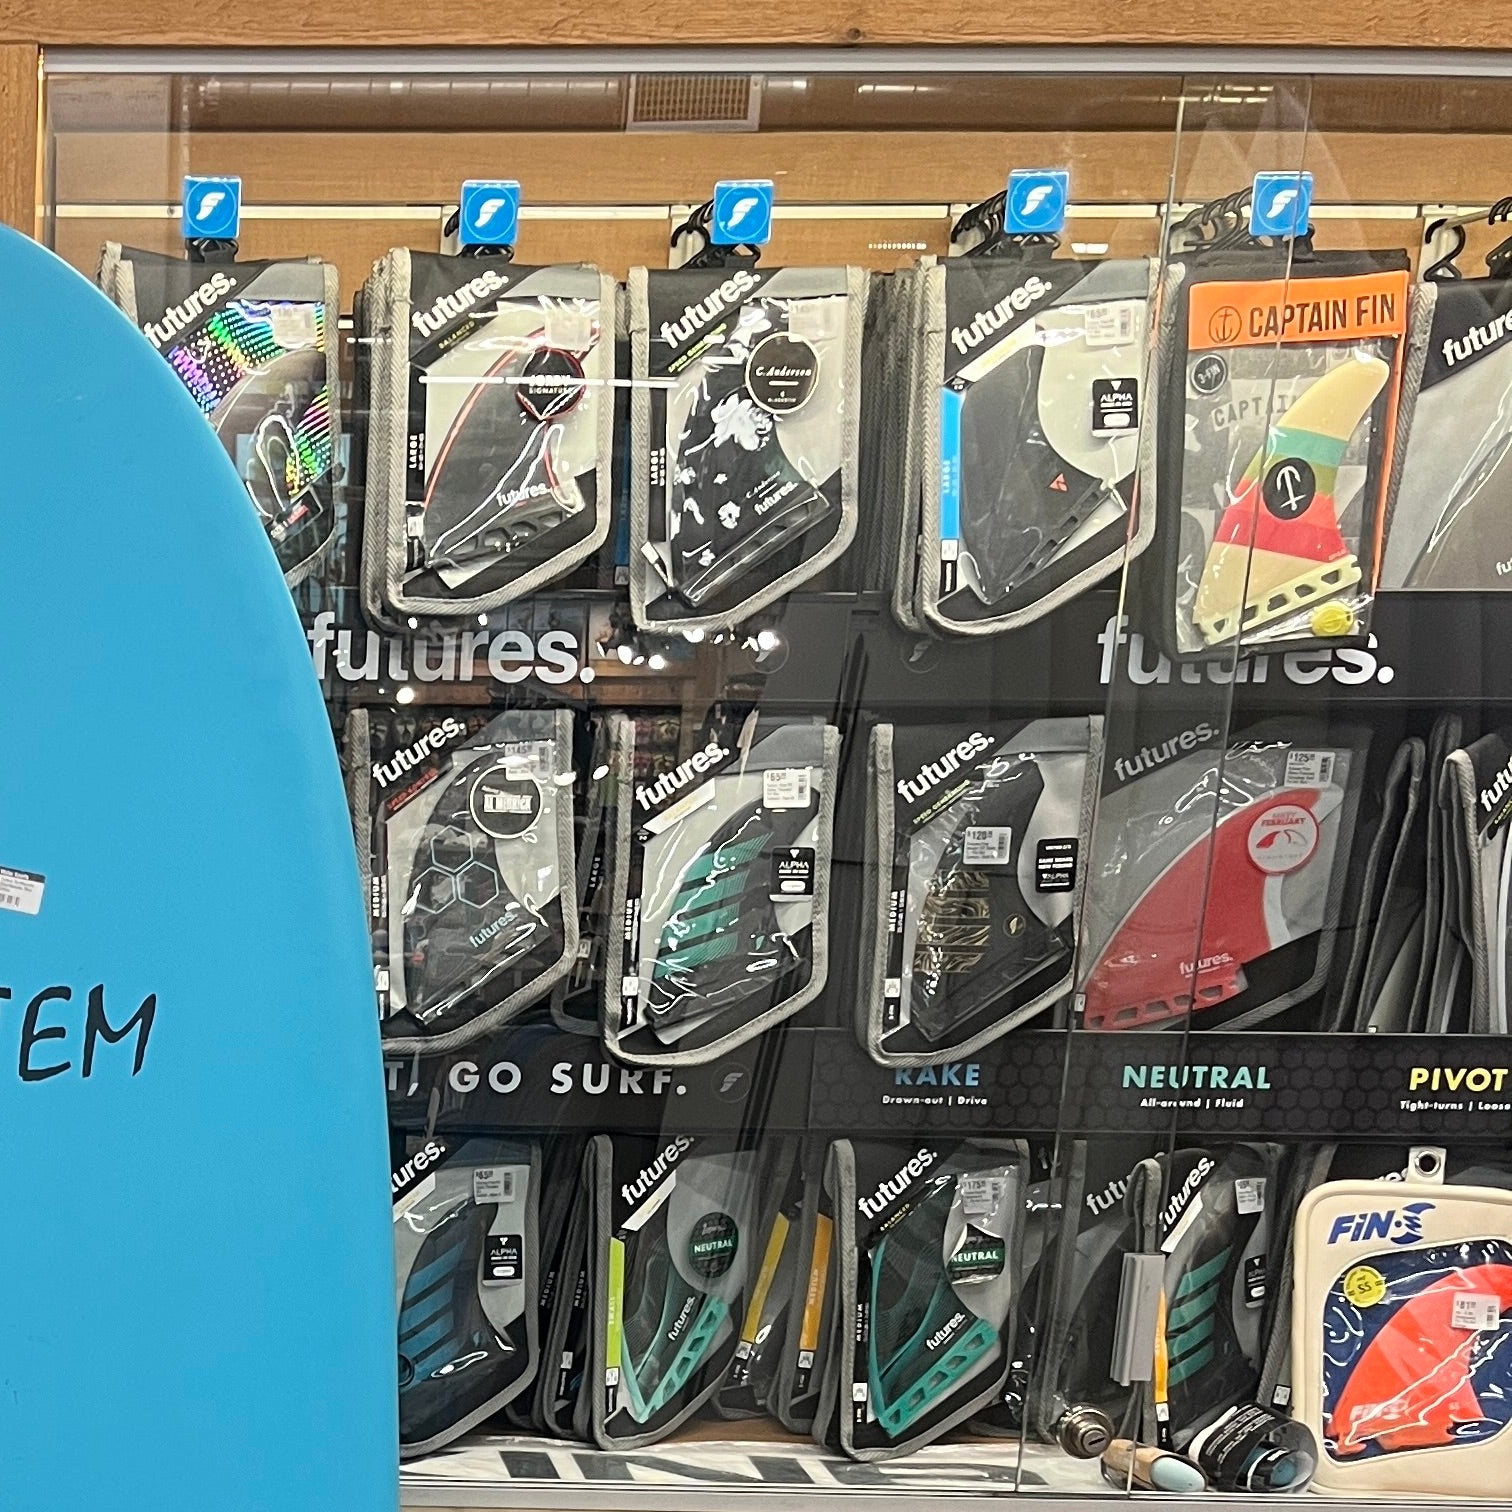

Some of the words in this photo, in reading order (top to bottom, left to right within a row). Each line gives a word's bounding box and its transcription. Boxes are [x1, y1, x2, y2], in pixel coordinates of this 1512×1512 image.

[144, 272, 238, 347] futures.
[412, 268, 510, 338] futures.
[660, 270, 761, 349] futures.
[951, 275, 1052, 354] futures.
[1249, 298, 1347, 338] CAPTAIN
[1356, 293, 1395, 327] FIN
[754, 480, 799, 516] futures.
[307, 612, 595, 684] futures.
[372, 714, 466, 788] futures.
[635, 741, 729, 811] futures.
[897, 730, 995, 803] futures.
[1113, 721, 1220, 781] futures.
[449, 1061, 521, 1094] GO
[550, 1061, 688, 1096] SURF.
[895, 1064, 981, 1087] RAKE
[1122, 1065, 1271, 1090] NEUTRAL
[1215, 1097, 1244, 1108] Fluid
[1409, 1067, 1509, 1092] PIVOT
[622, 1134, 695, 1206] futures.
[858, 1145, 937, 1220] futures.
[694, 1239, 733, 1254] NEUTRAL
[668, 1295, 696, 1342] futures.
[926, 1312, 967, 1351] futures.
